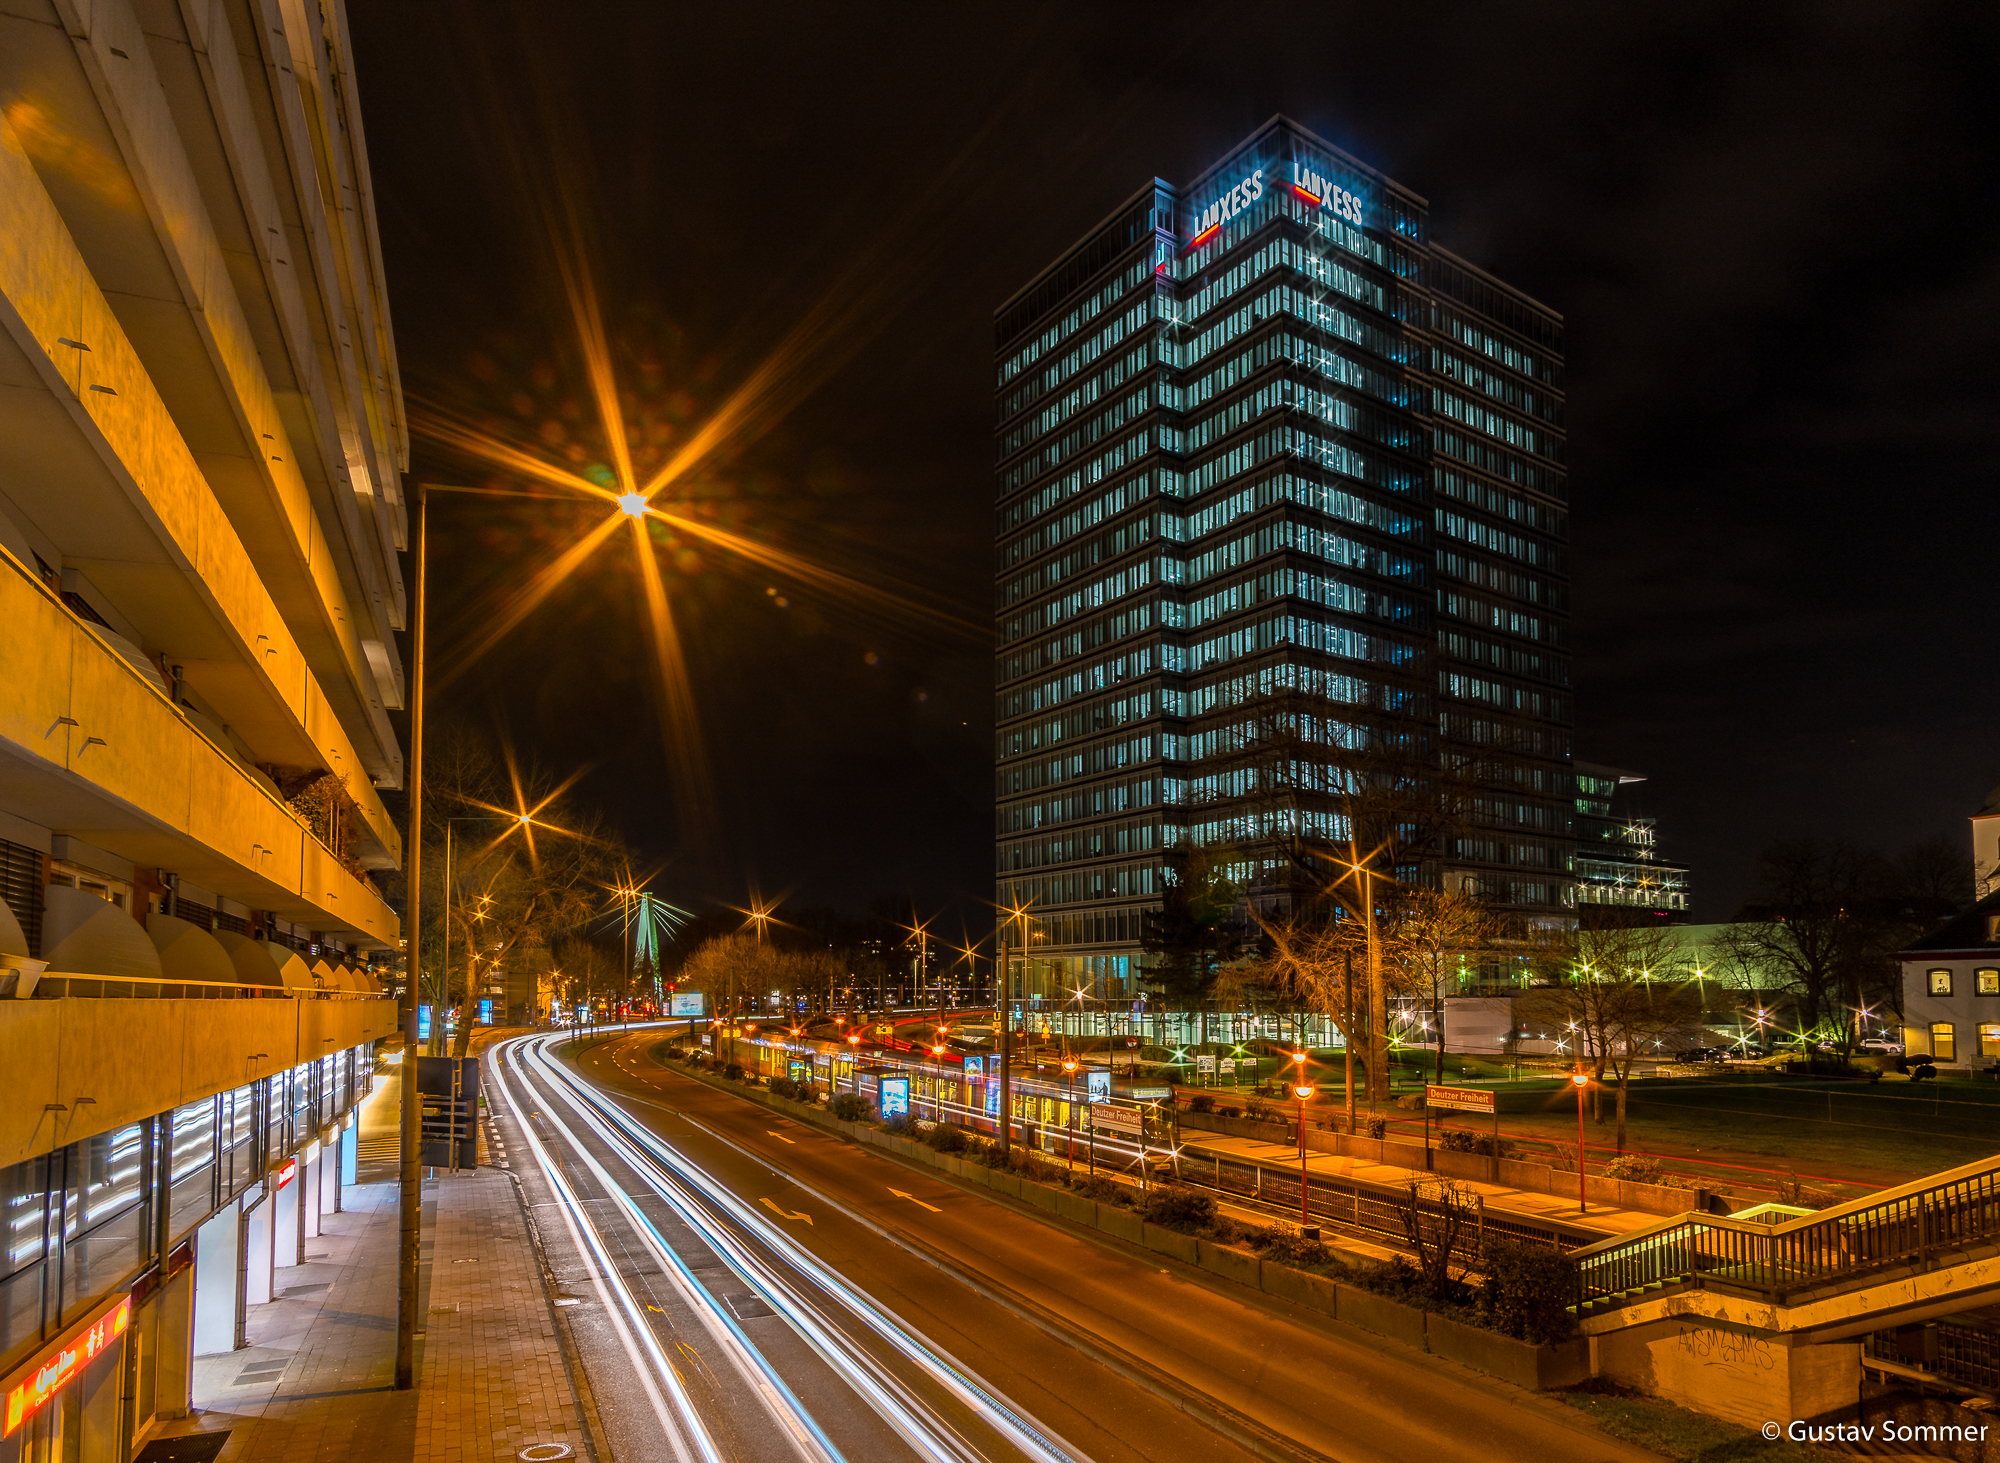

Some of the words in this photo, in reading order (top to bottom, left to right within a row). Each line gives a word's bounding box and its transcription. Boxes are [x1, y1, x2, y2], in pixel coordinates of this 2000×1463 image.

[1294, 162, 1362, 226] LANXESS
[1194, 169, 1263, 238] LANXESS
[993, 1012, 1001, 1021] U
[1430, 1089, 1458, 1100] Deutzer
[1460, 1092, 1489, 1103] Freiheit
[1091, 1106, 1115, 1118] Deutzer
[1116, 1110, 1141, 1124] Freiheit
